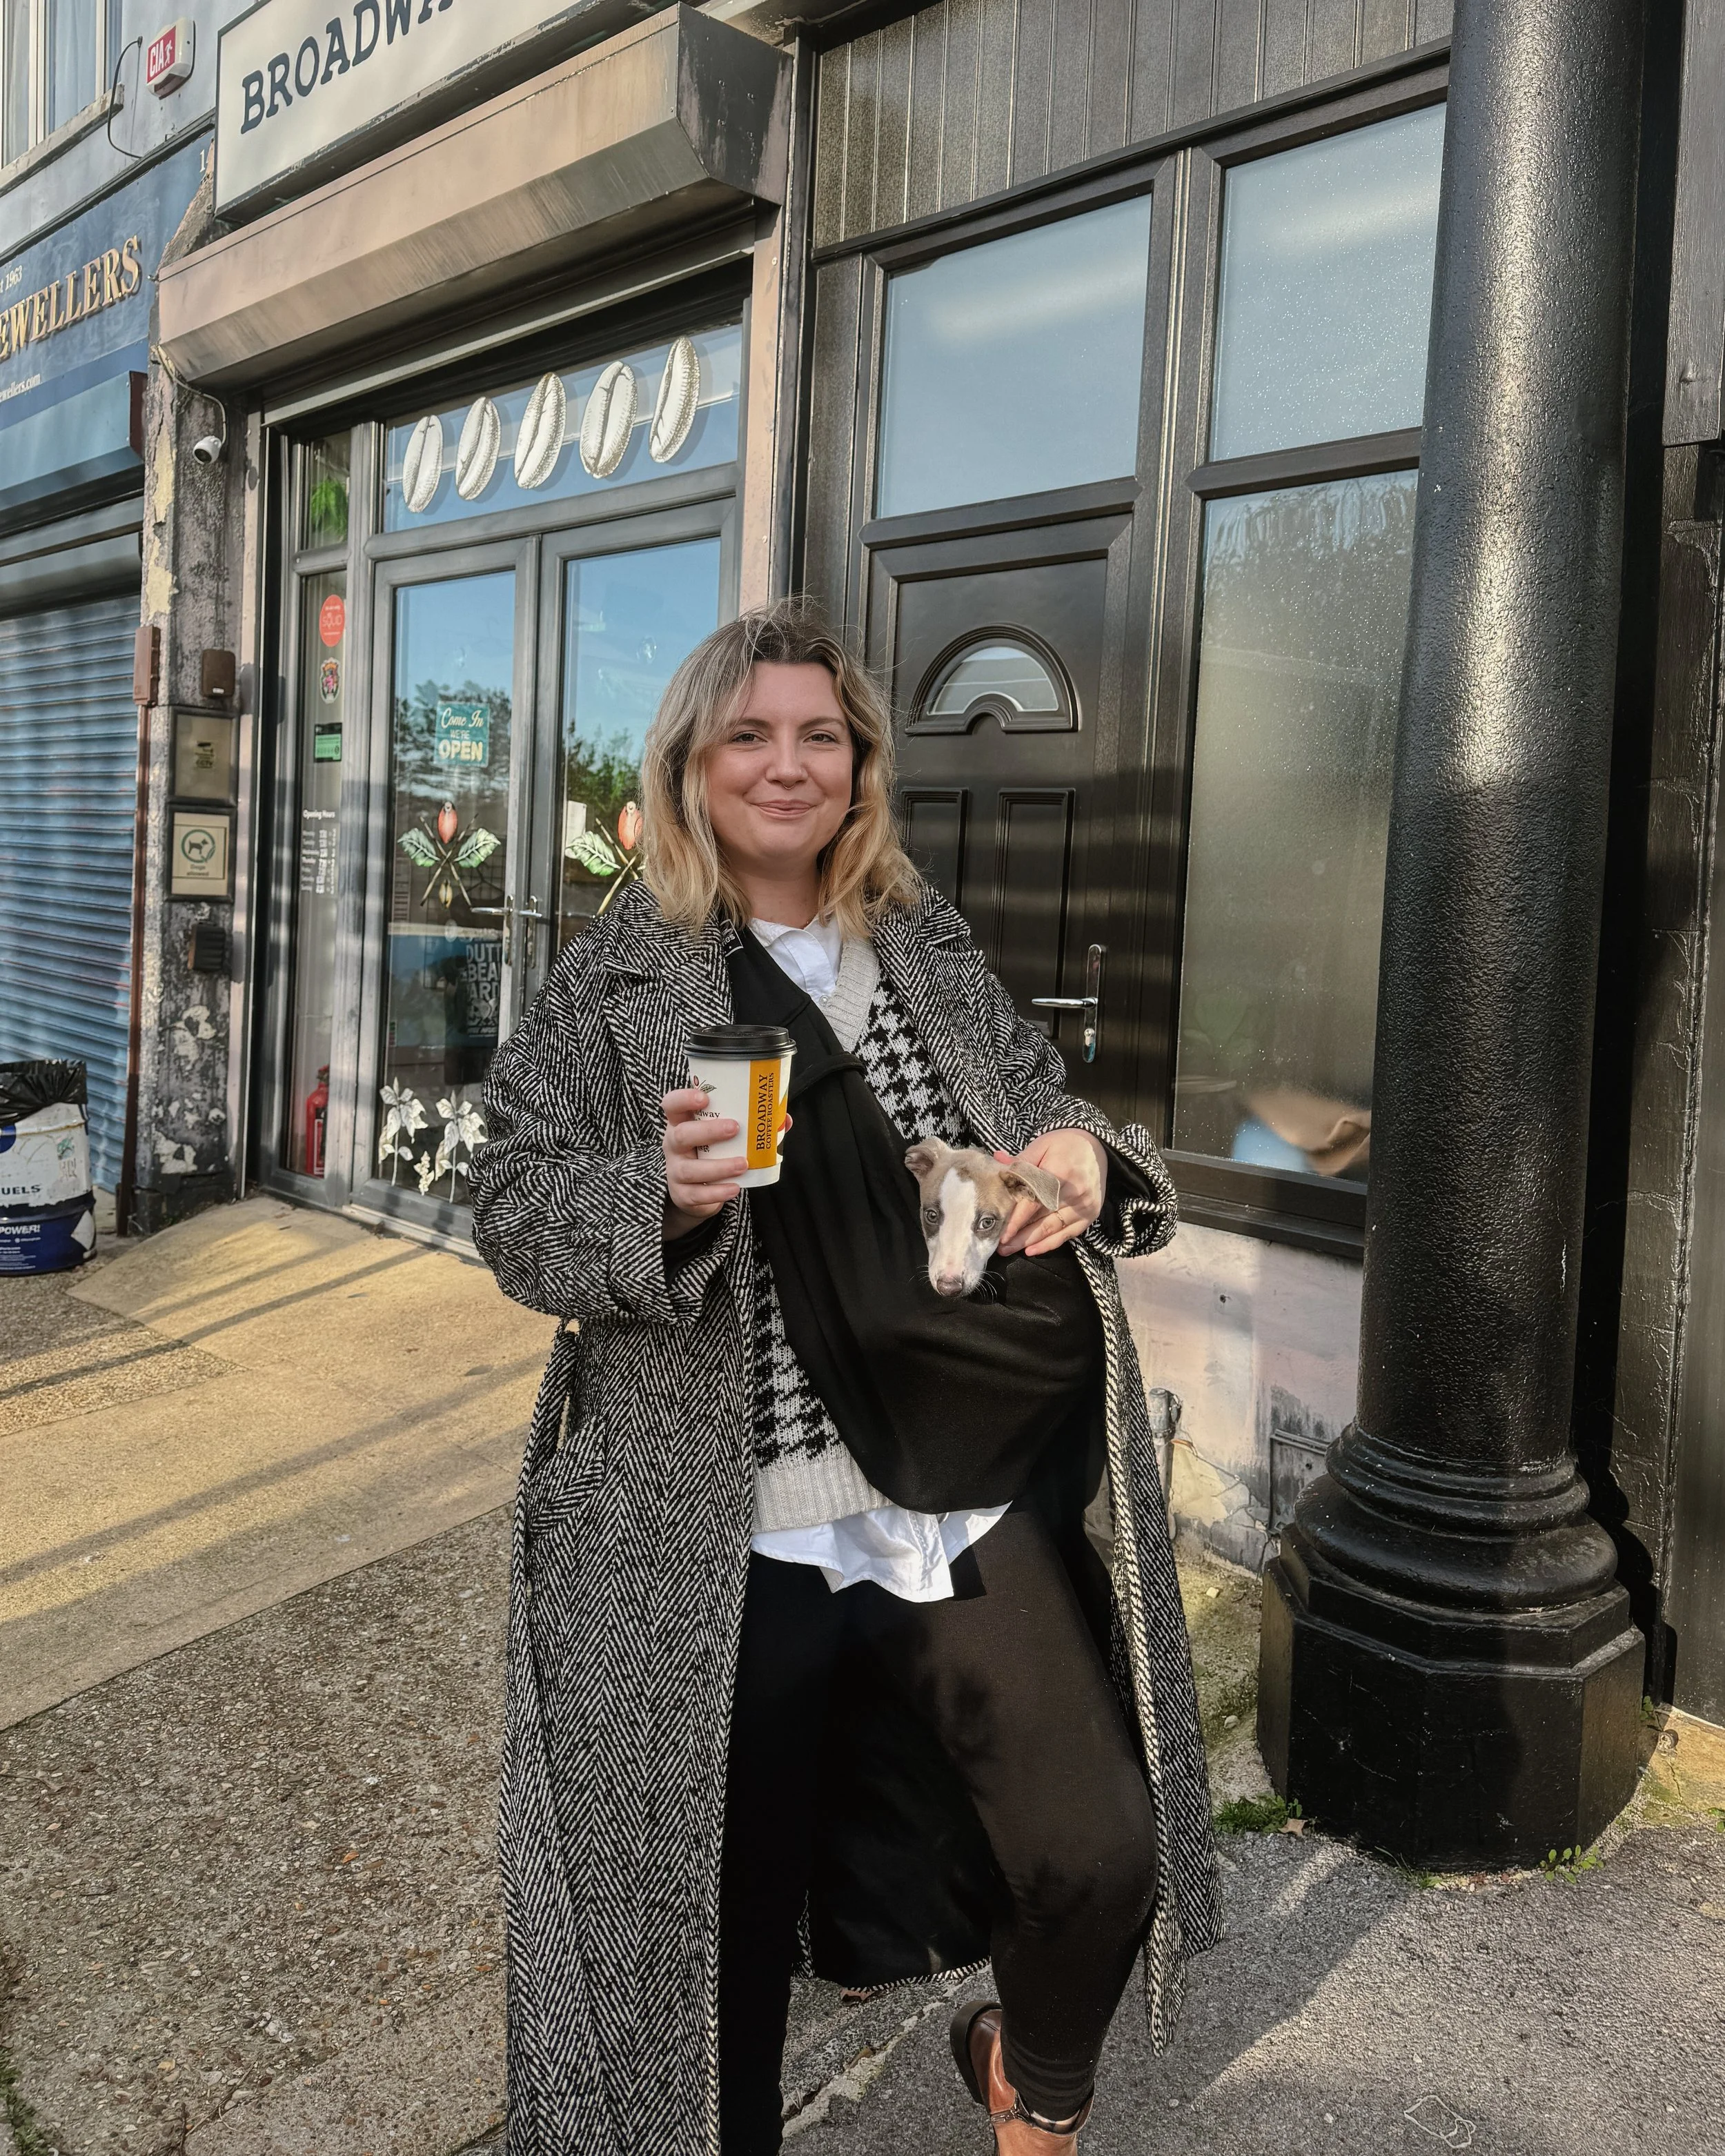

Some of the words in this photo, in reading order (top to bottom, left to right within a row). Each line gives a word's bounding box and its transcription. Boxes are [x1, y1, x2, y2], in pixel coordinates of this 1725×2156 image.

[150, 39, 165, 78] CIA
[6, 265, 23, 290] 1963
[442, 707, 466, 728] Come
[469, 710, 484, 727] In
[439, 739, 483, 762] OPEN
[469, 962, 500, 982] BEA
[756, 1074, 768, 1150] BROADWAY
[1, 1184, 41, 1195] UELS
